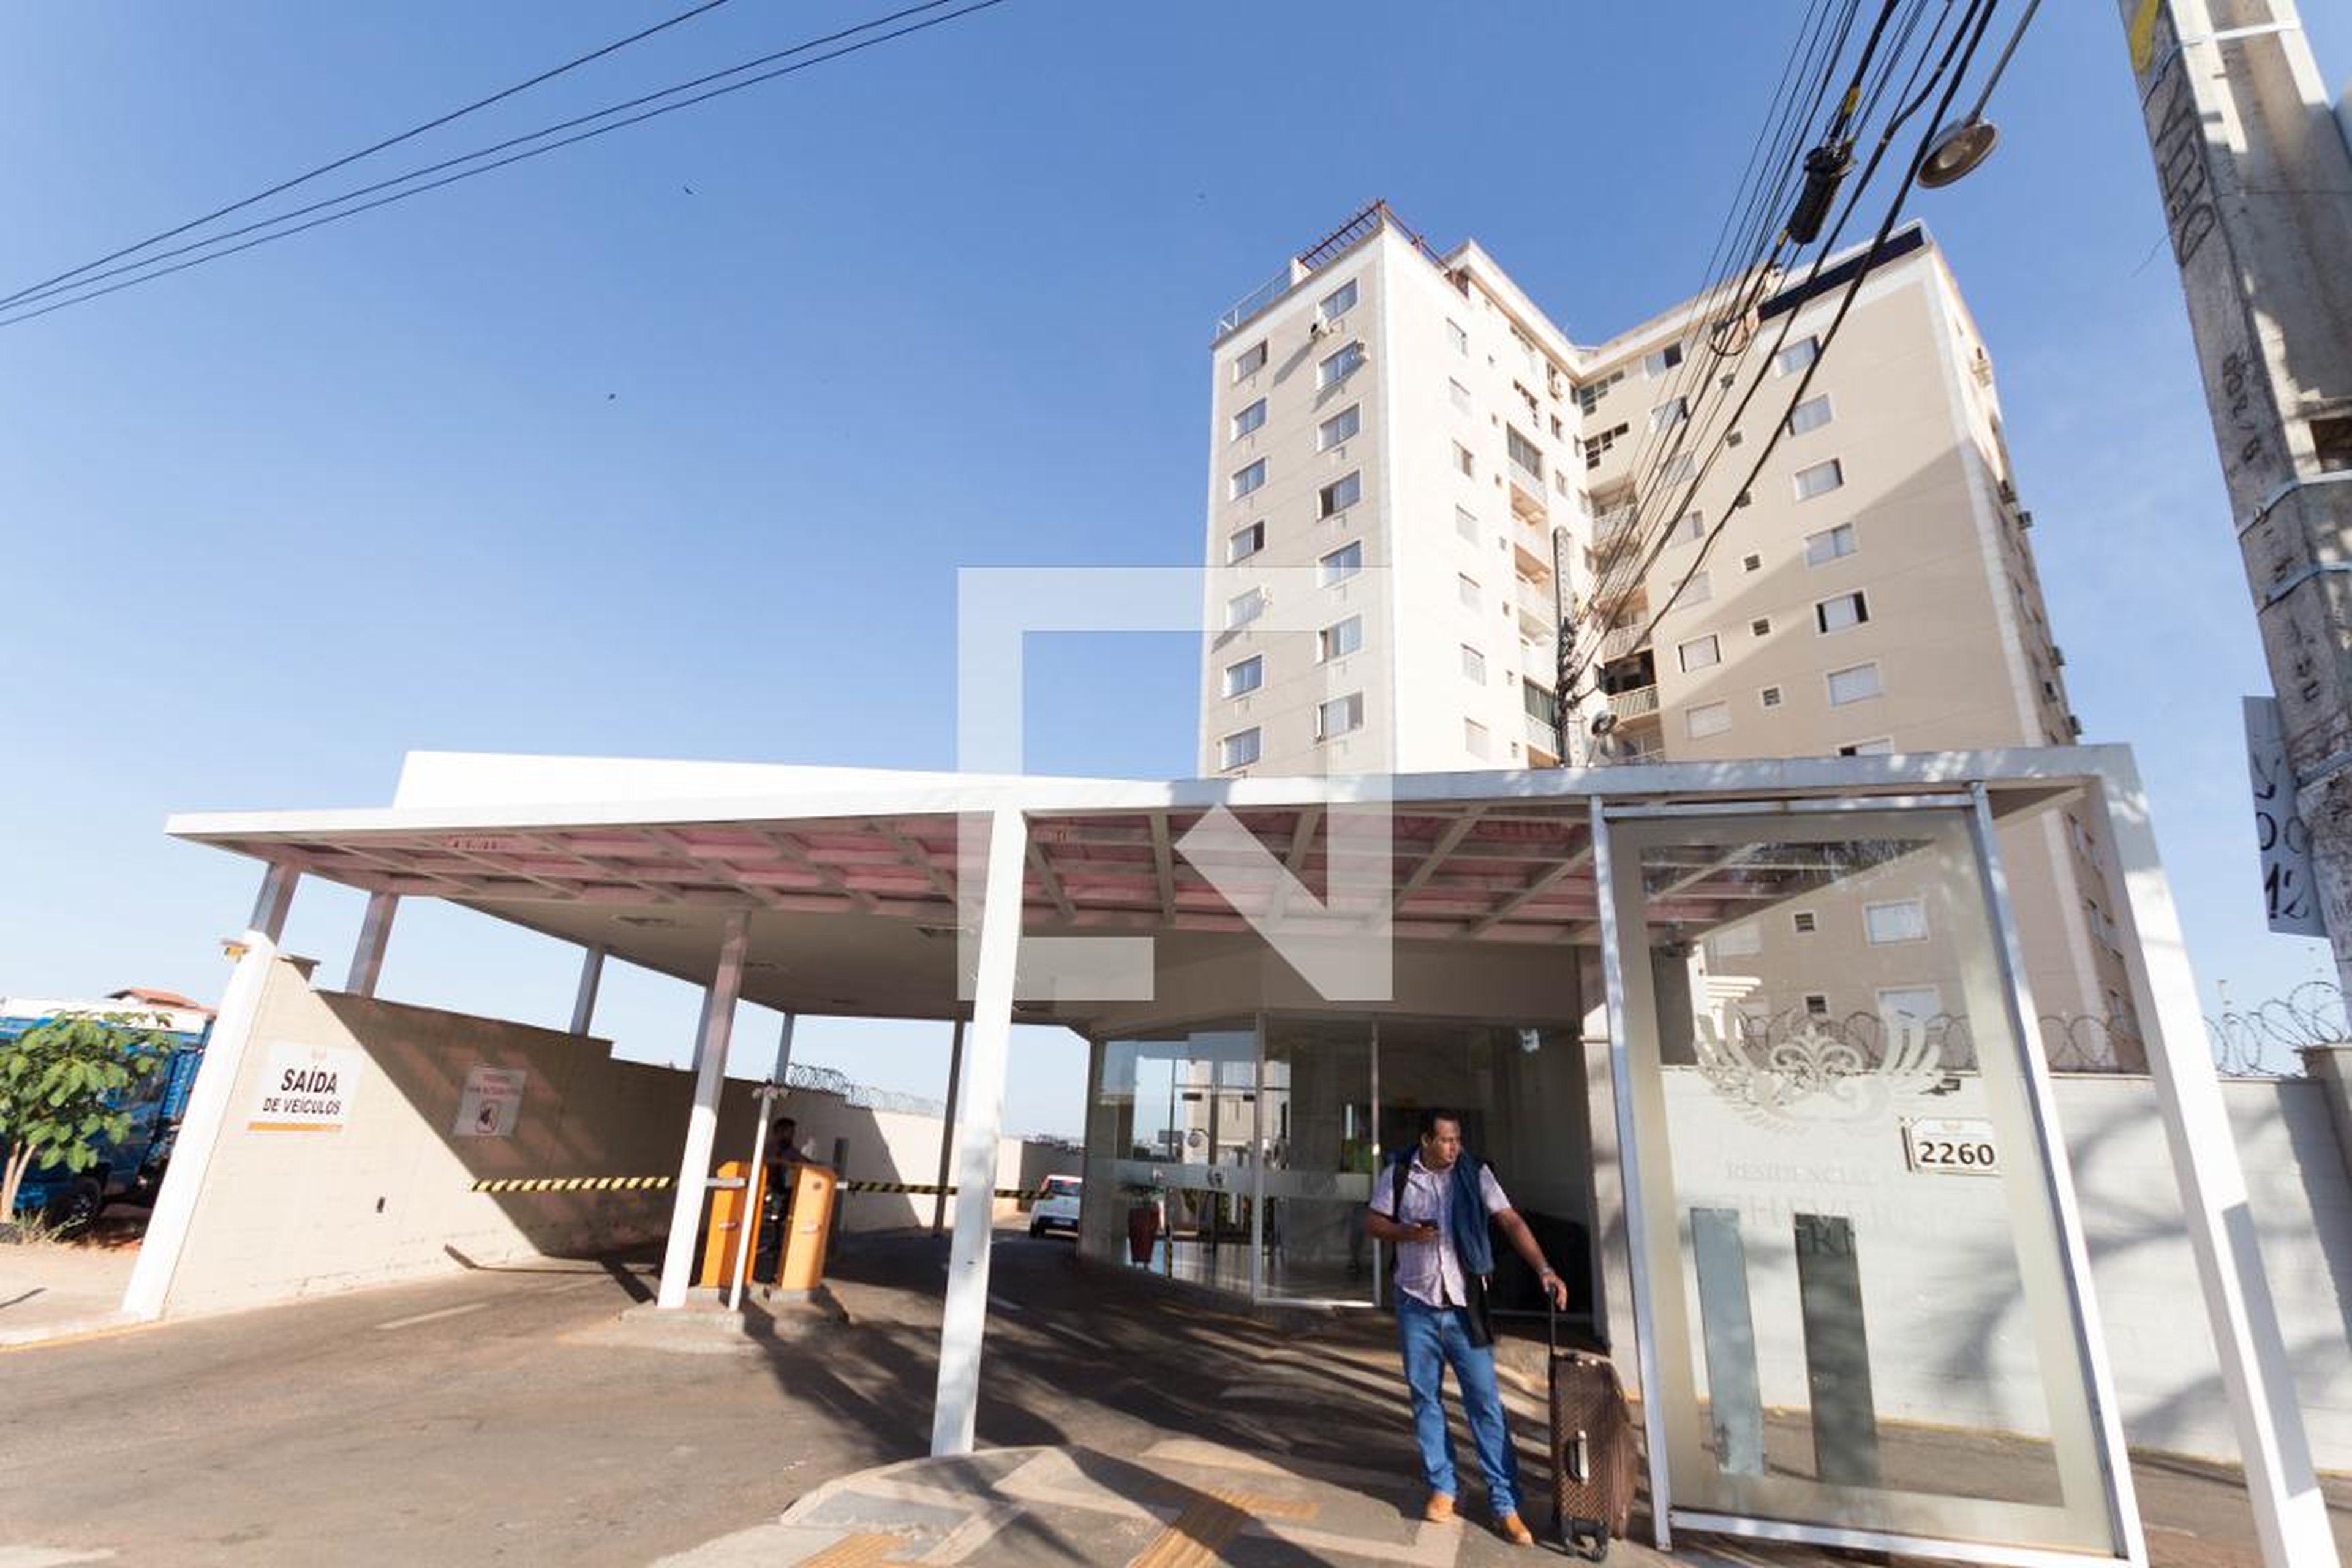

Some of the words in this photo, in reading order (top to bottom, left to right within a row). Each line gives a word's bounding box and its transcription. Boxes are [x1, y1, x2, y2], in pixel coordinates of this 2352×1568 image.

[281, 1065, 337, 1094] SAÍDA
[263, 1098, 281, 1112] DE
[1918, 1141, 1995, 1166] 2260
